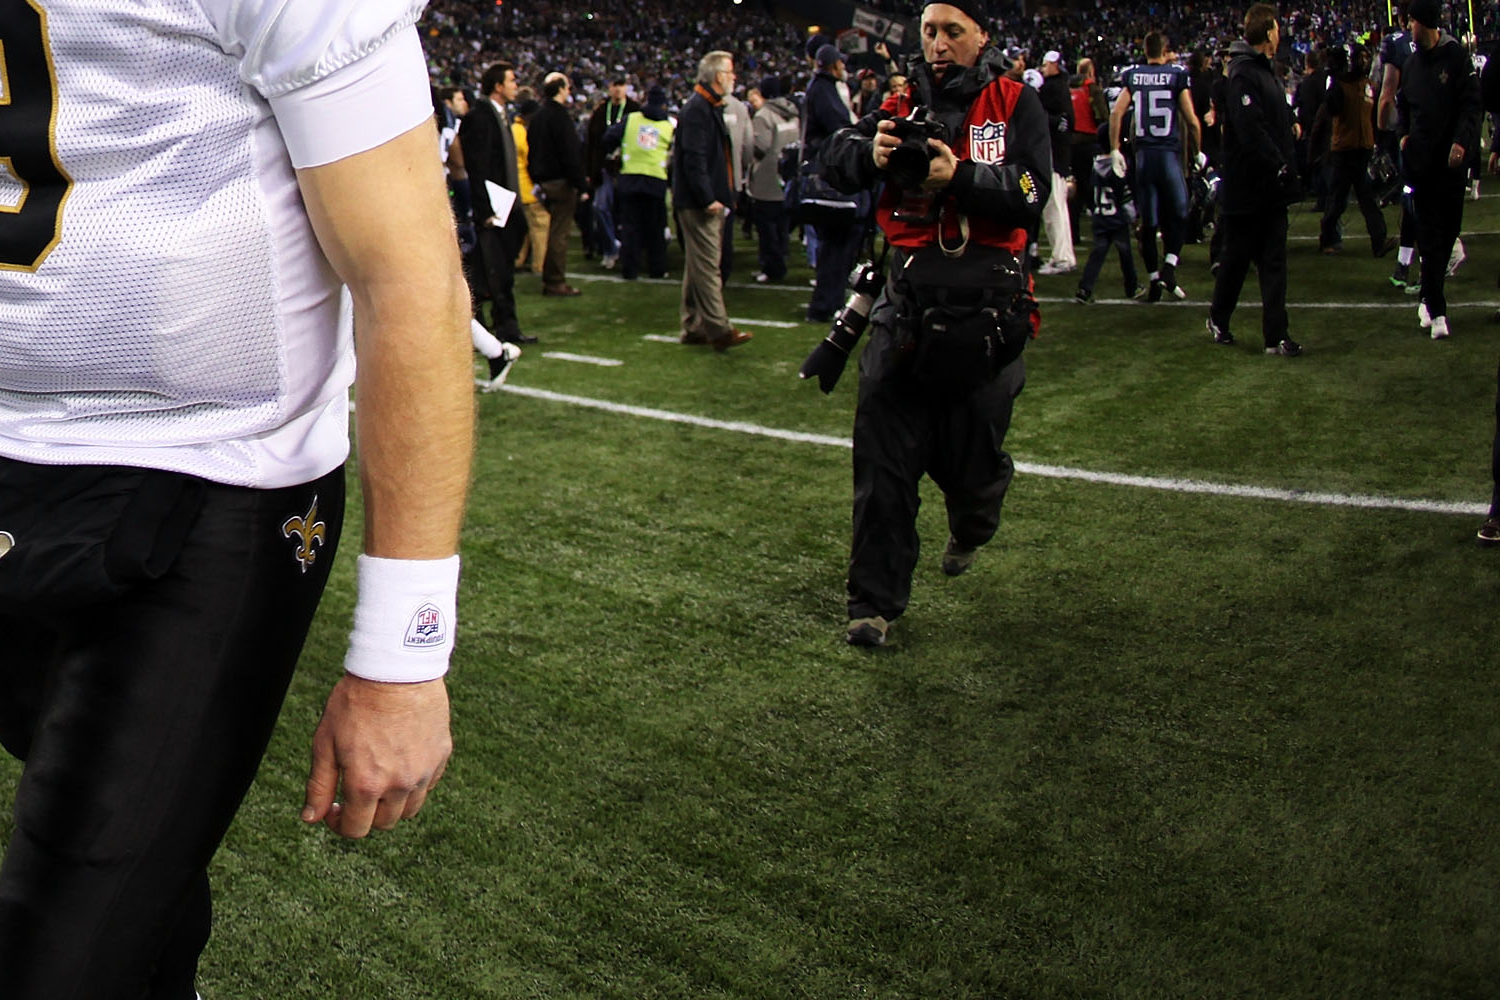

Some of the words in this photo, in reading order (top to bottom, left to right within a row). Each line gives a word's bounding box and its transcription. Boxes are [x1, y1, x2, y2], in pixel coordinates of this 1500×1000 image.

[1133, 73, 1172, 85] STOKLEY
[1132, 90, 1173, 137] 15
[975, 138, 1005, 163] NFL
[1093, 185, 1117, 216] 15
[420, 611, 437, 625] NFL
